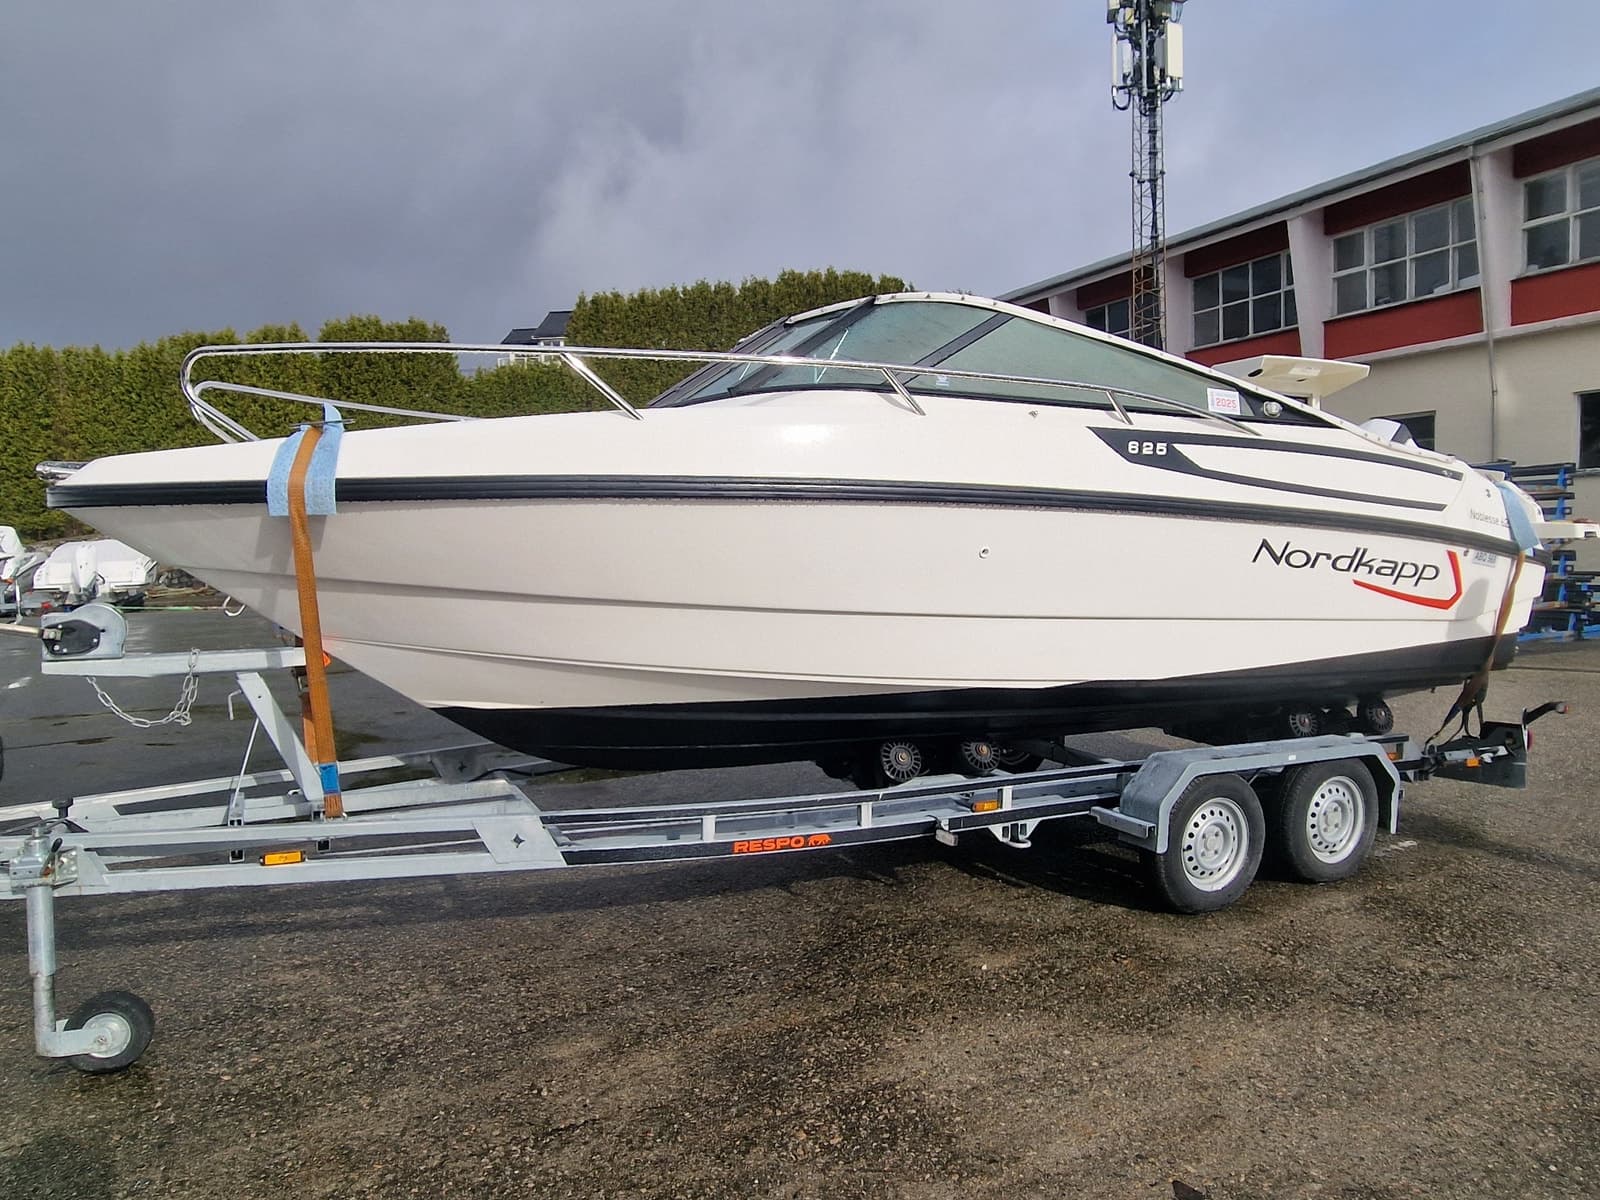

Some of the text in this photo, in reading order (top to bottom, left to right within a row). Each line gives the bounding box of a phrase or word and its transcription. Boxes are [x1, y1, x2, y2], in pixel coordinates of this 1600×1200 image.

[1215, 397, 1237, 409] 2025
[1128, 441, 1167, 455] 625
[1252, 538, 1440, 587] Nordkapp
[733, 836, 804, 853] RESPO
